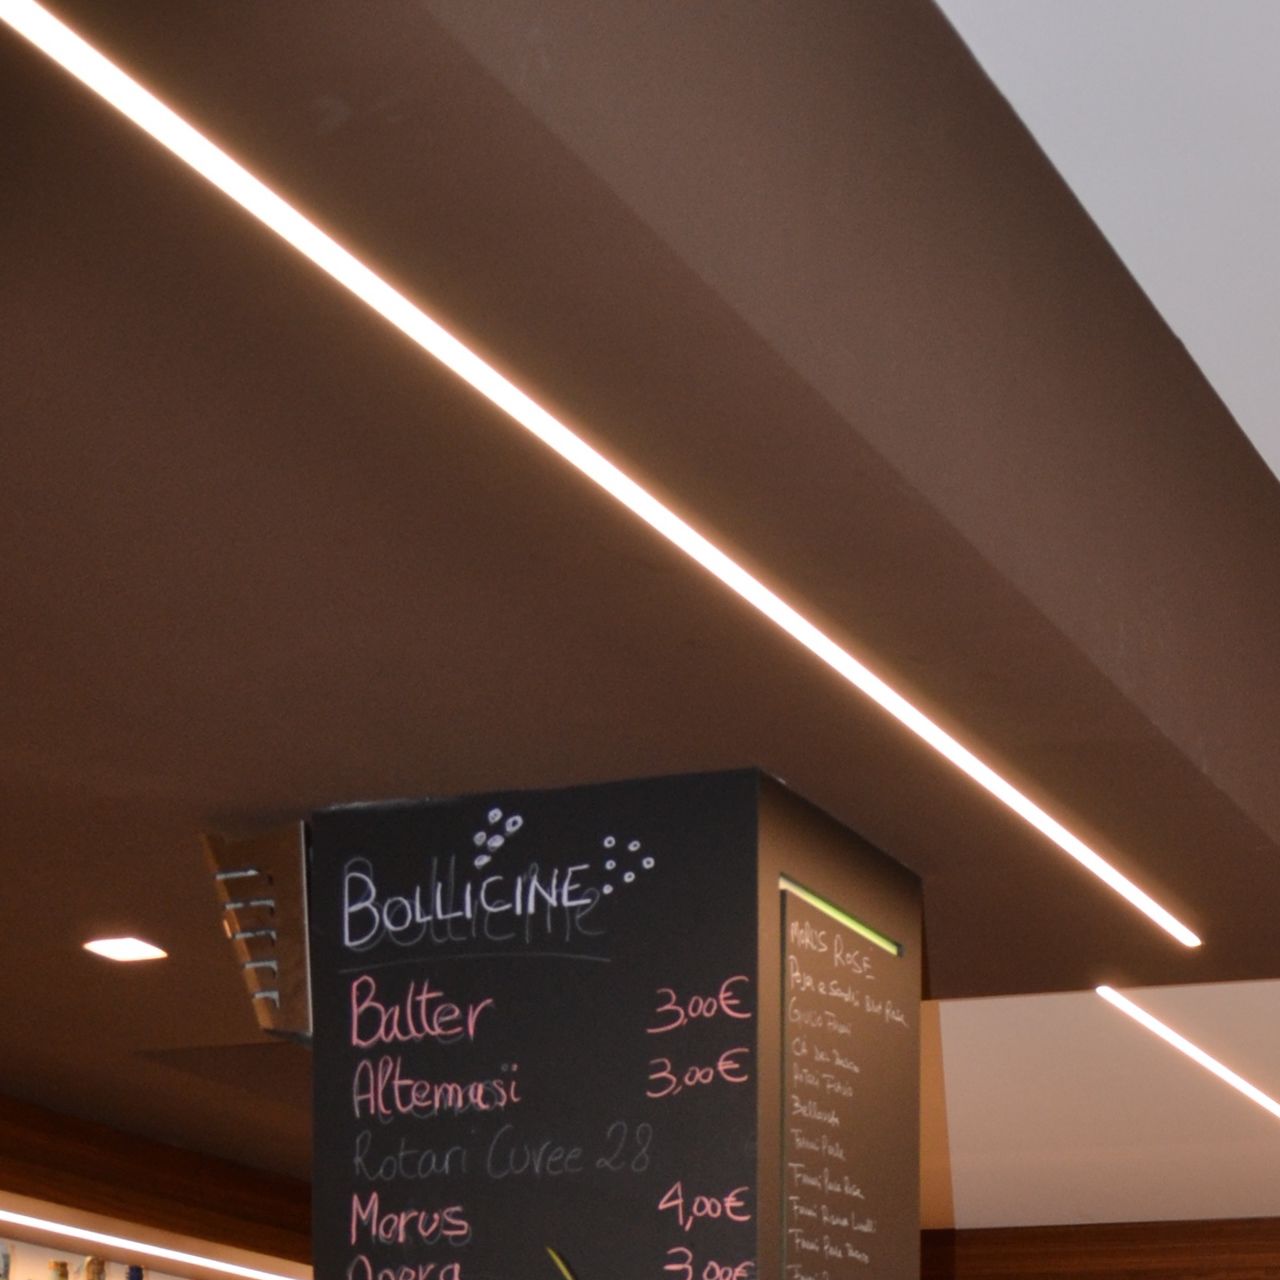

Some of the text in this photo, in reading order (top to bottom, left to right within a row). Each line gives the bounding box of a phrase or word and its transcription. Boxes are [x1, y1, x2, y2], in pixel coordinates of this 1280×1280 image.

[344, 864, 592, 946] BOLLICINE
[351, 975, 751, 1047] Balter 3,00€
[354, 1056, 520, 1118] Altemasi
[646, 1047, 750, 1098] 3,00€
[596, 1121, 653, 1172] 28
[351, 1192, 470, 1244] Morus
[658, 1181, 751, 1231] 4,00€
